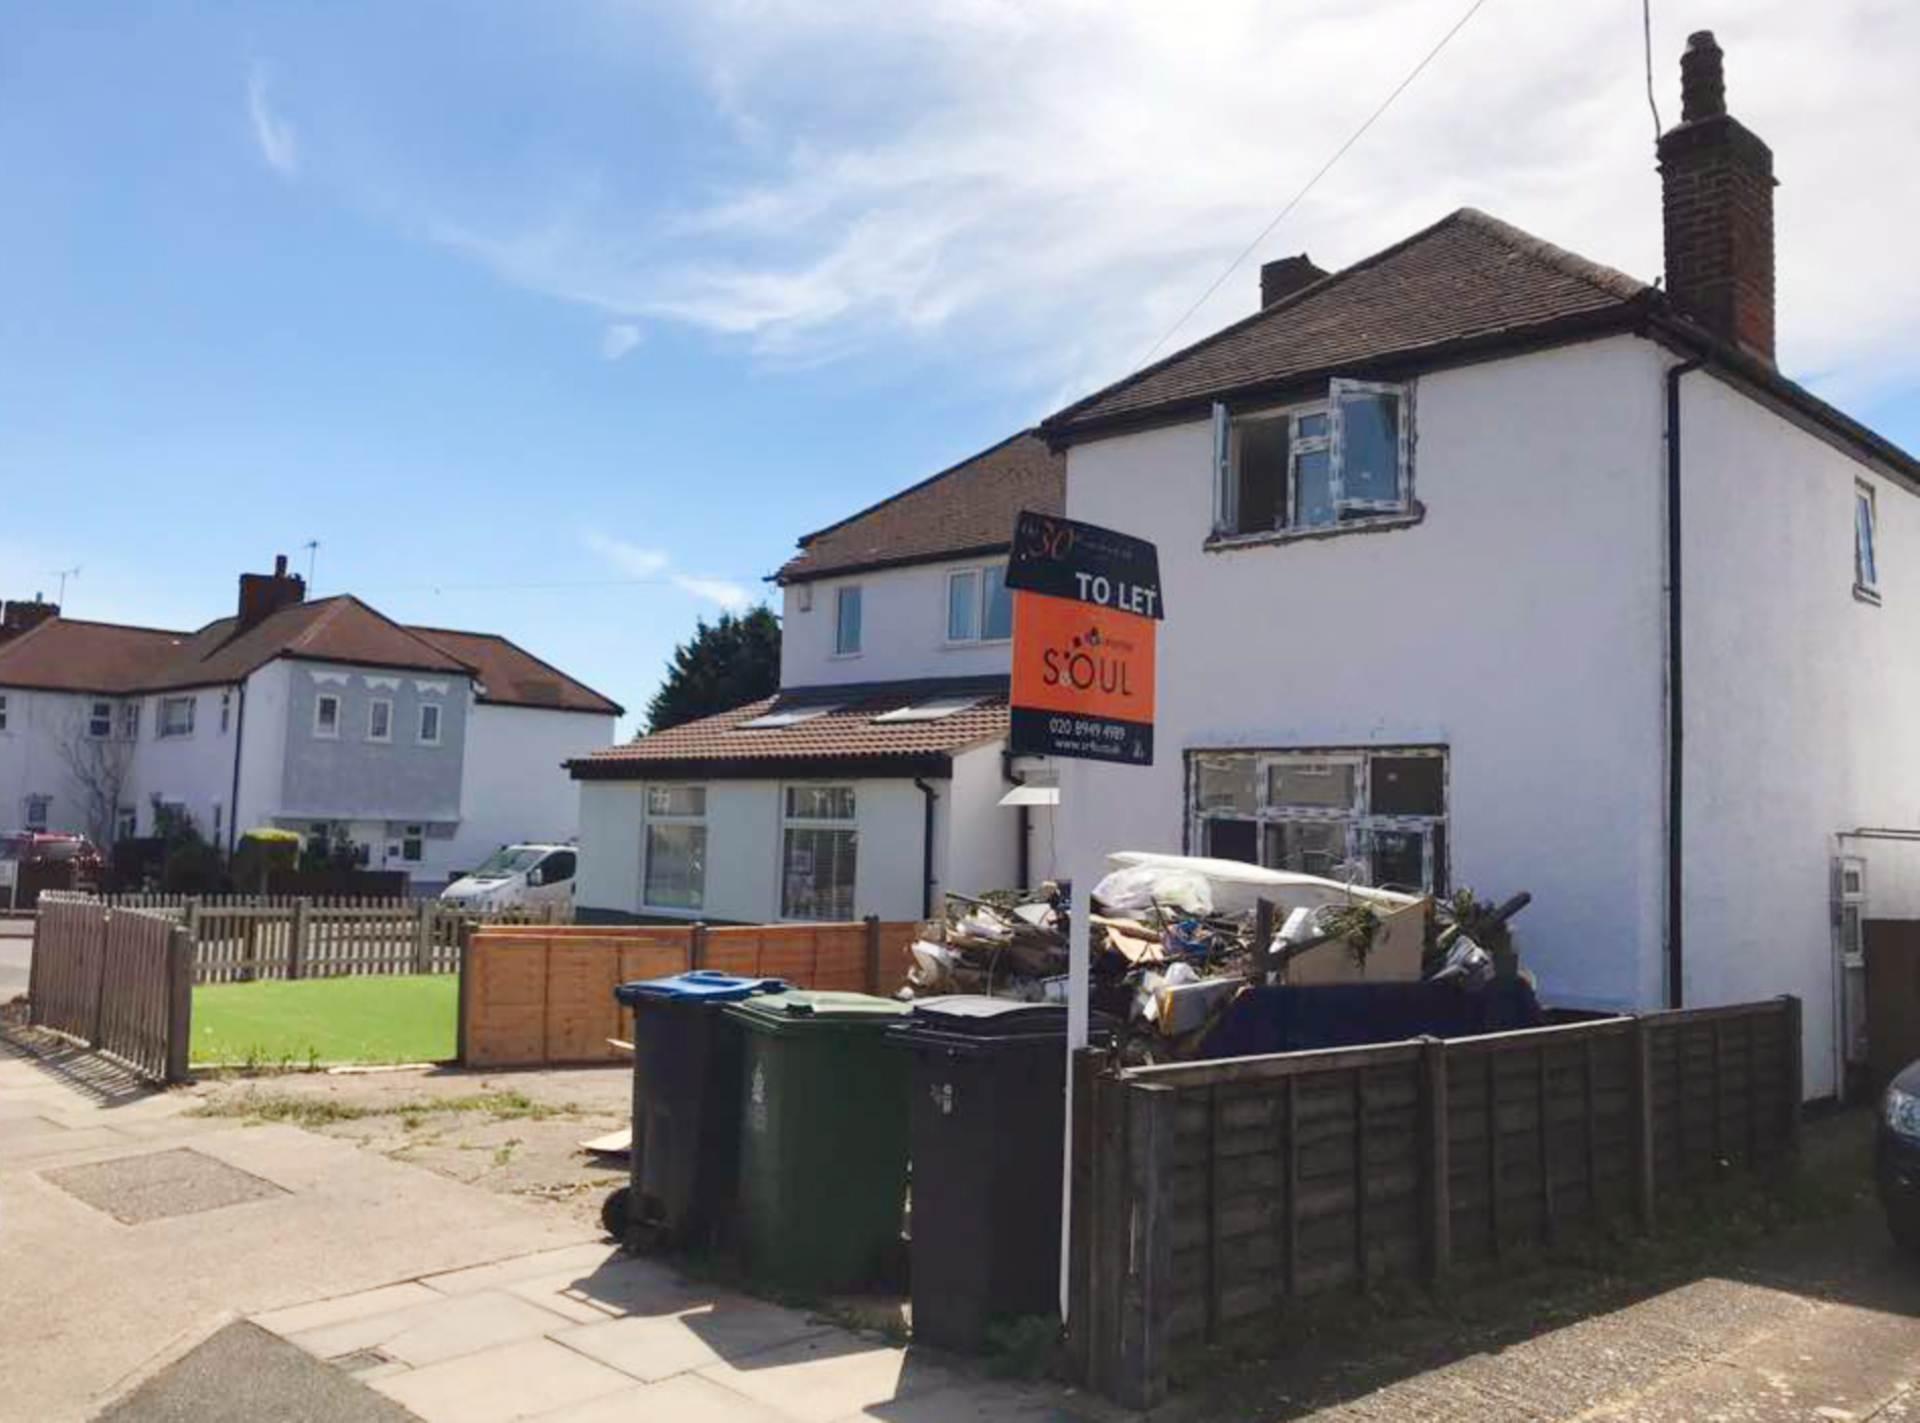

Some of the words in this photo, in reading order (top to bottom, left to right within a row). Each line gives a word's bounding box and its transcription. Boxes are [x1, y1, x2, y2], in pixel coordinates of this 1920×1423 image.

[1076, 571, 1110, 604] TO
[1118, 582, 1157, 615] LET
[1050, 718, 1073, 734] 020
